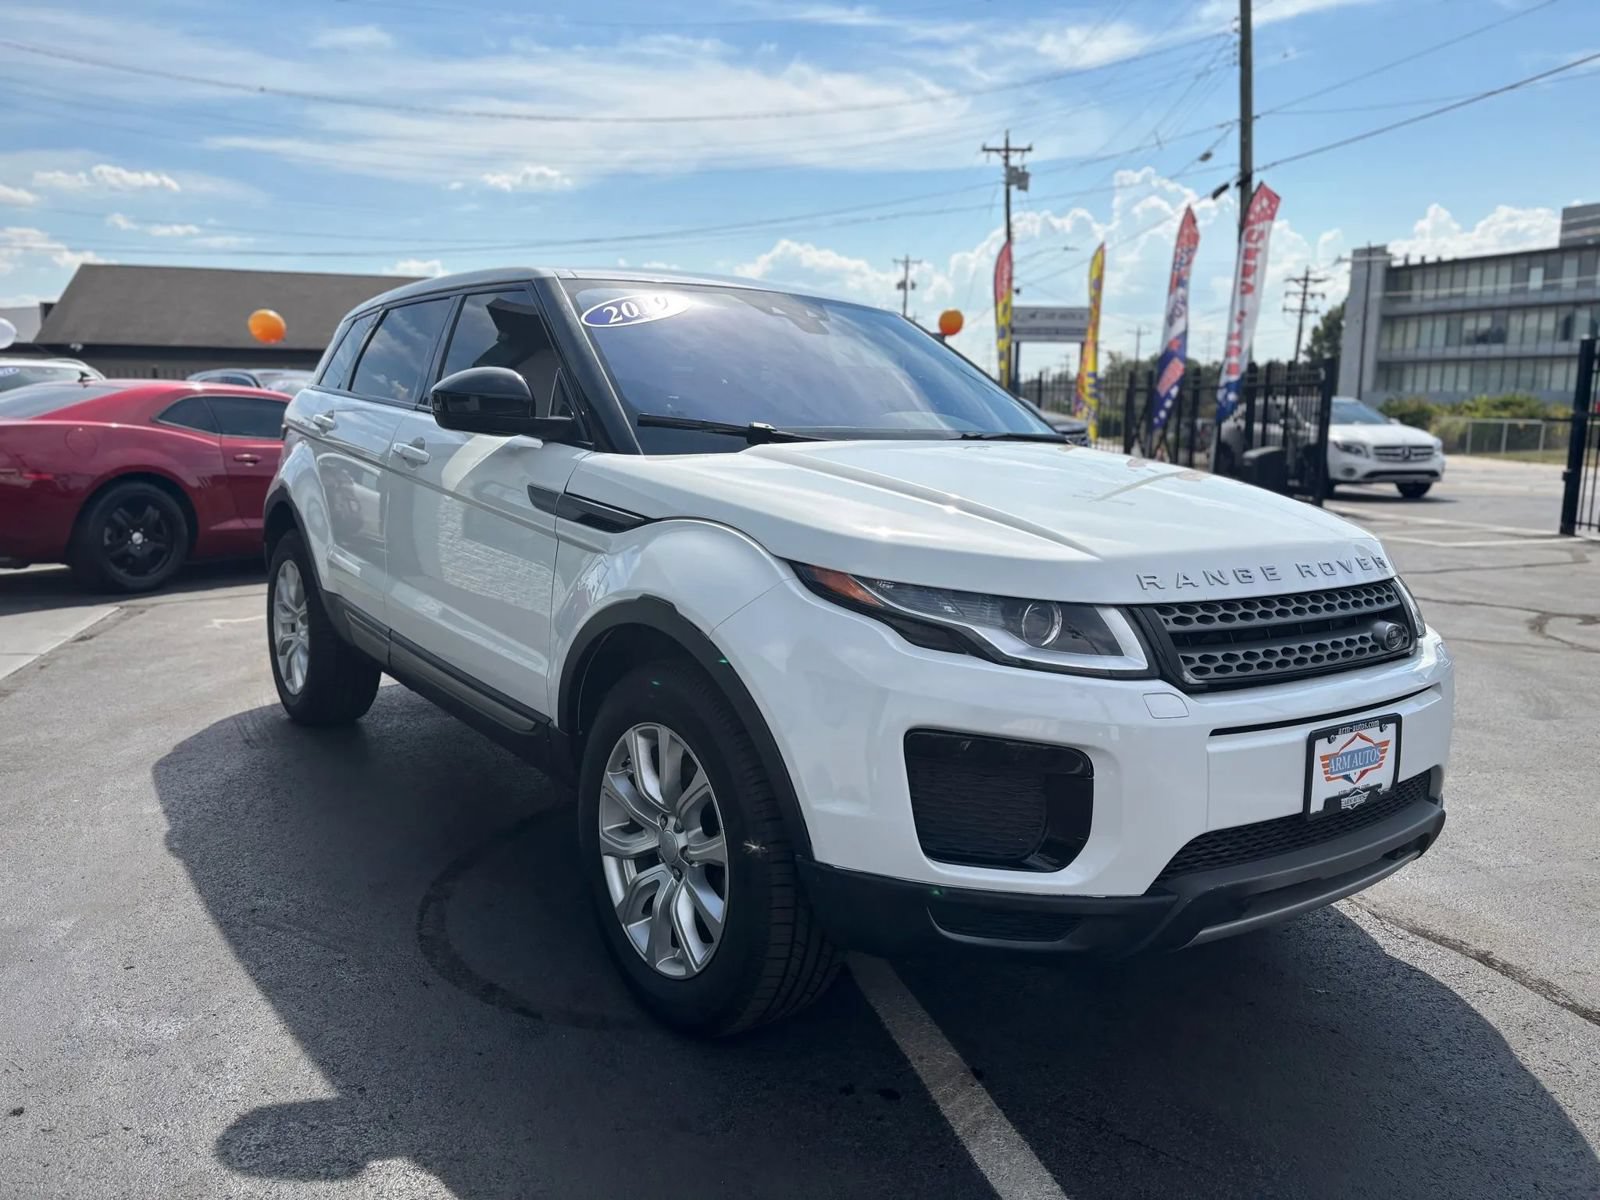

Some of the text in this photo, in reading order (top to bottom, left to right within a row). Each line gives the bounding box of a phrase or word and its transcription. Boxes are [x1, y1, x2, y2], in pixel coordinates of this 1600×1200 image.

[602, 296, 669, 324] 2019
[1136, 555, 1388, 591] RANGE ROVER
[1329, 748, 1381, 773] ARM AUTOS
